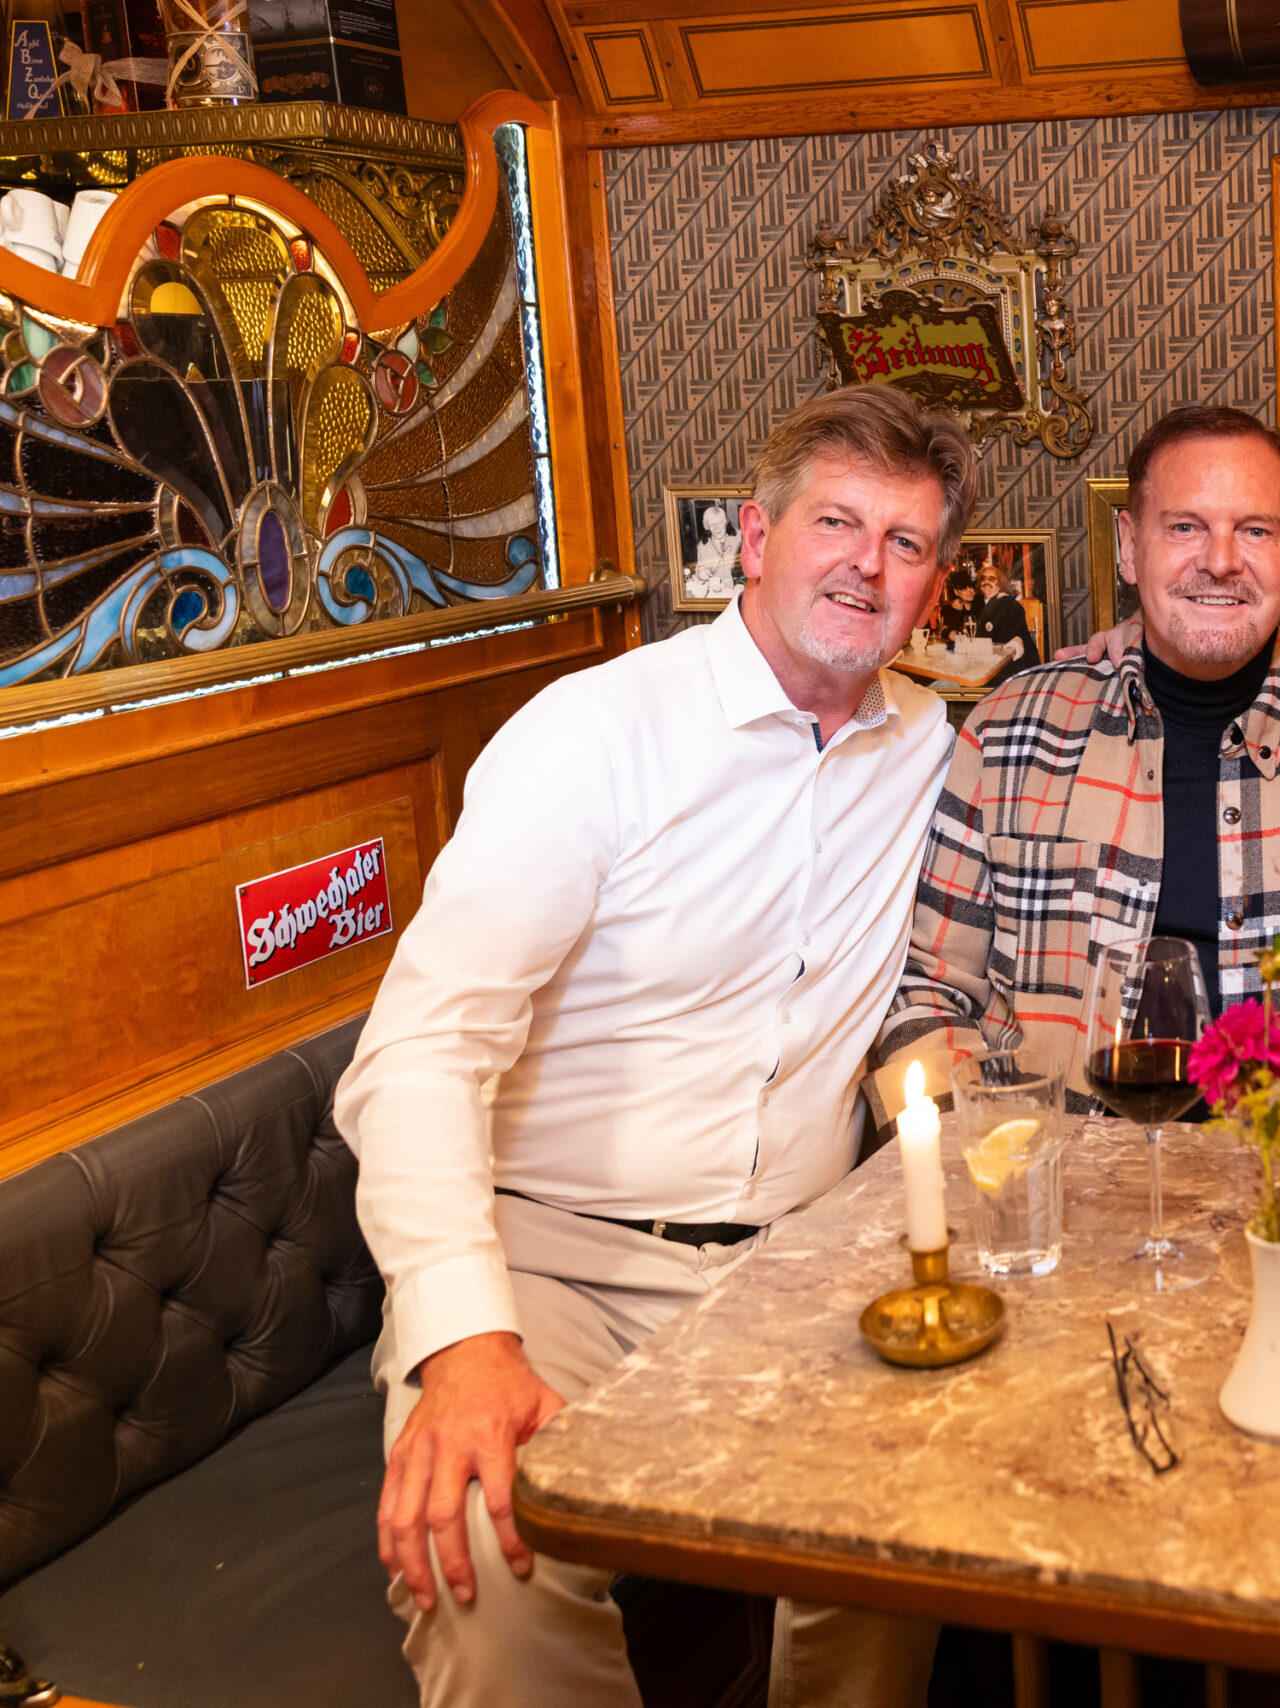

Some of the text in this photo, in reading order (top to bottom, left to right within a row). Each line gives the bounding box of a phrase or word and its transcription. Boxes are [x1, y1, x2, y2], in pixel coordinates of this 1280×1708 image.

[847, 323, 996, 387] Zeitung
[247, 848, 381, 968] Schwechater
[329, 901, 385, 949] Bier
